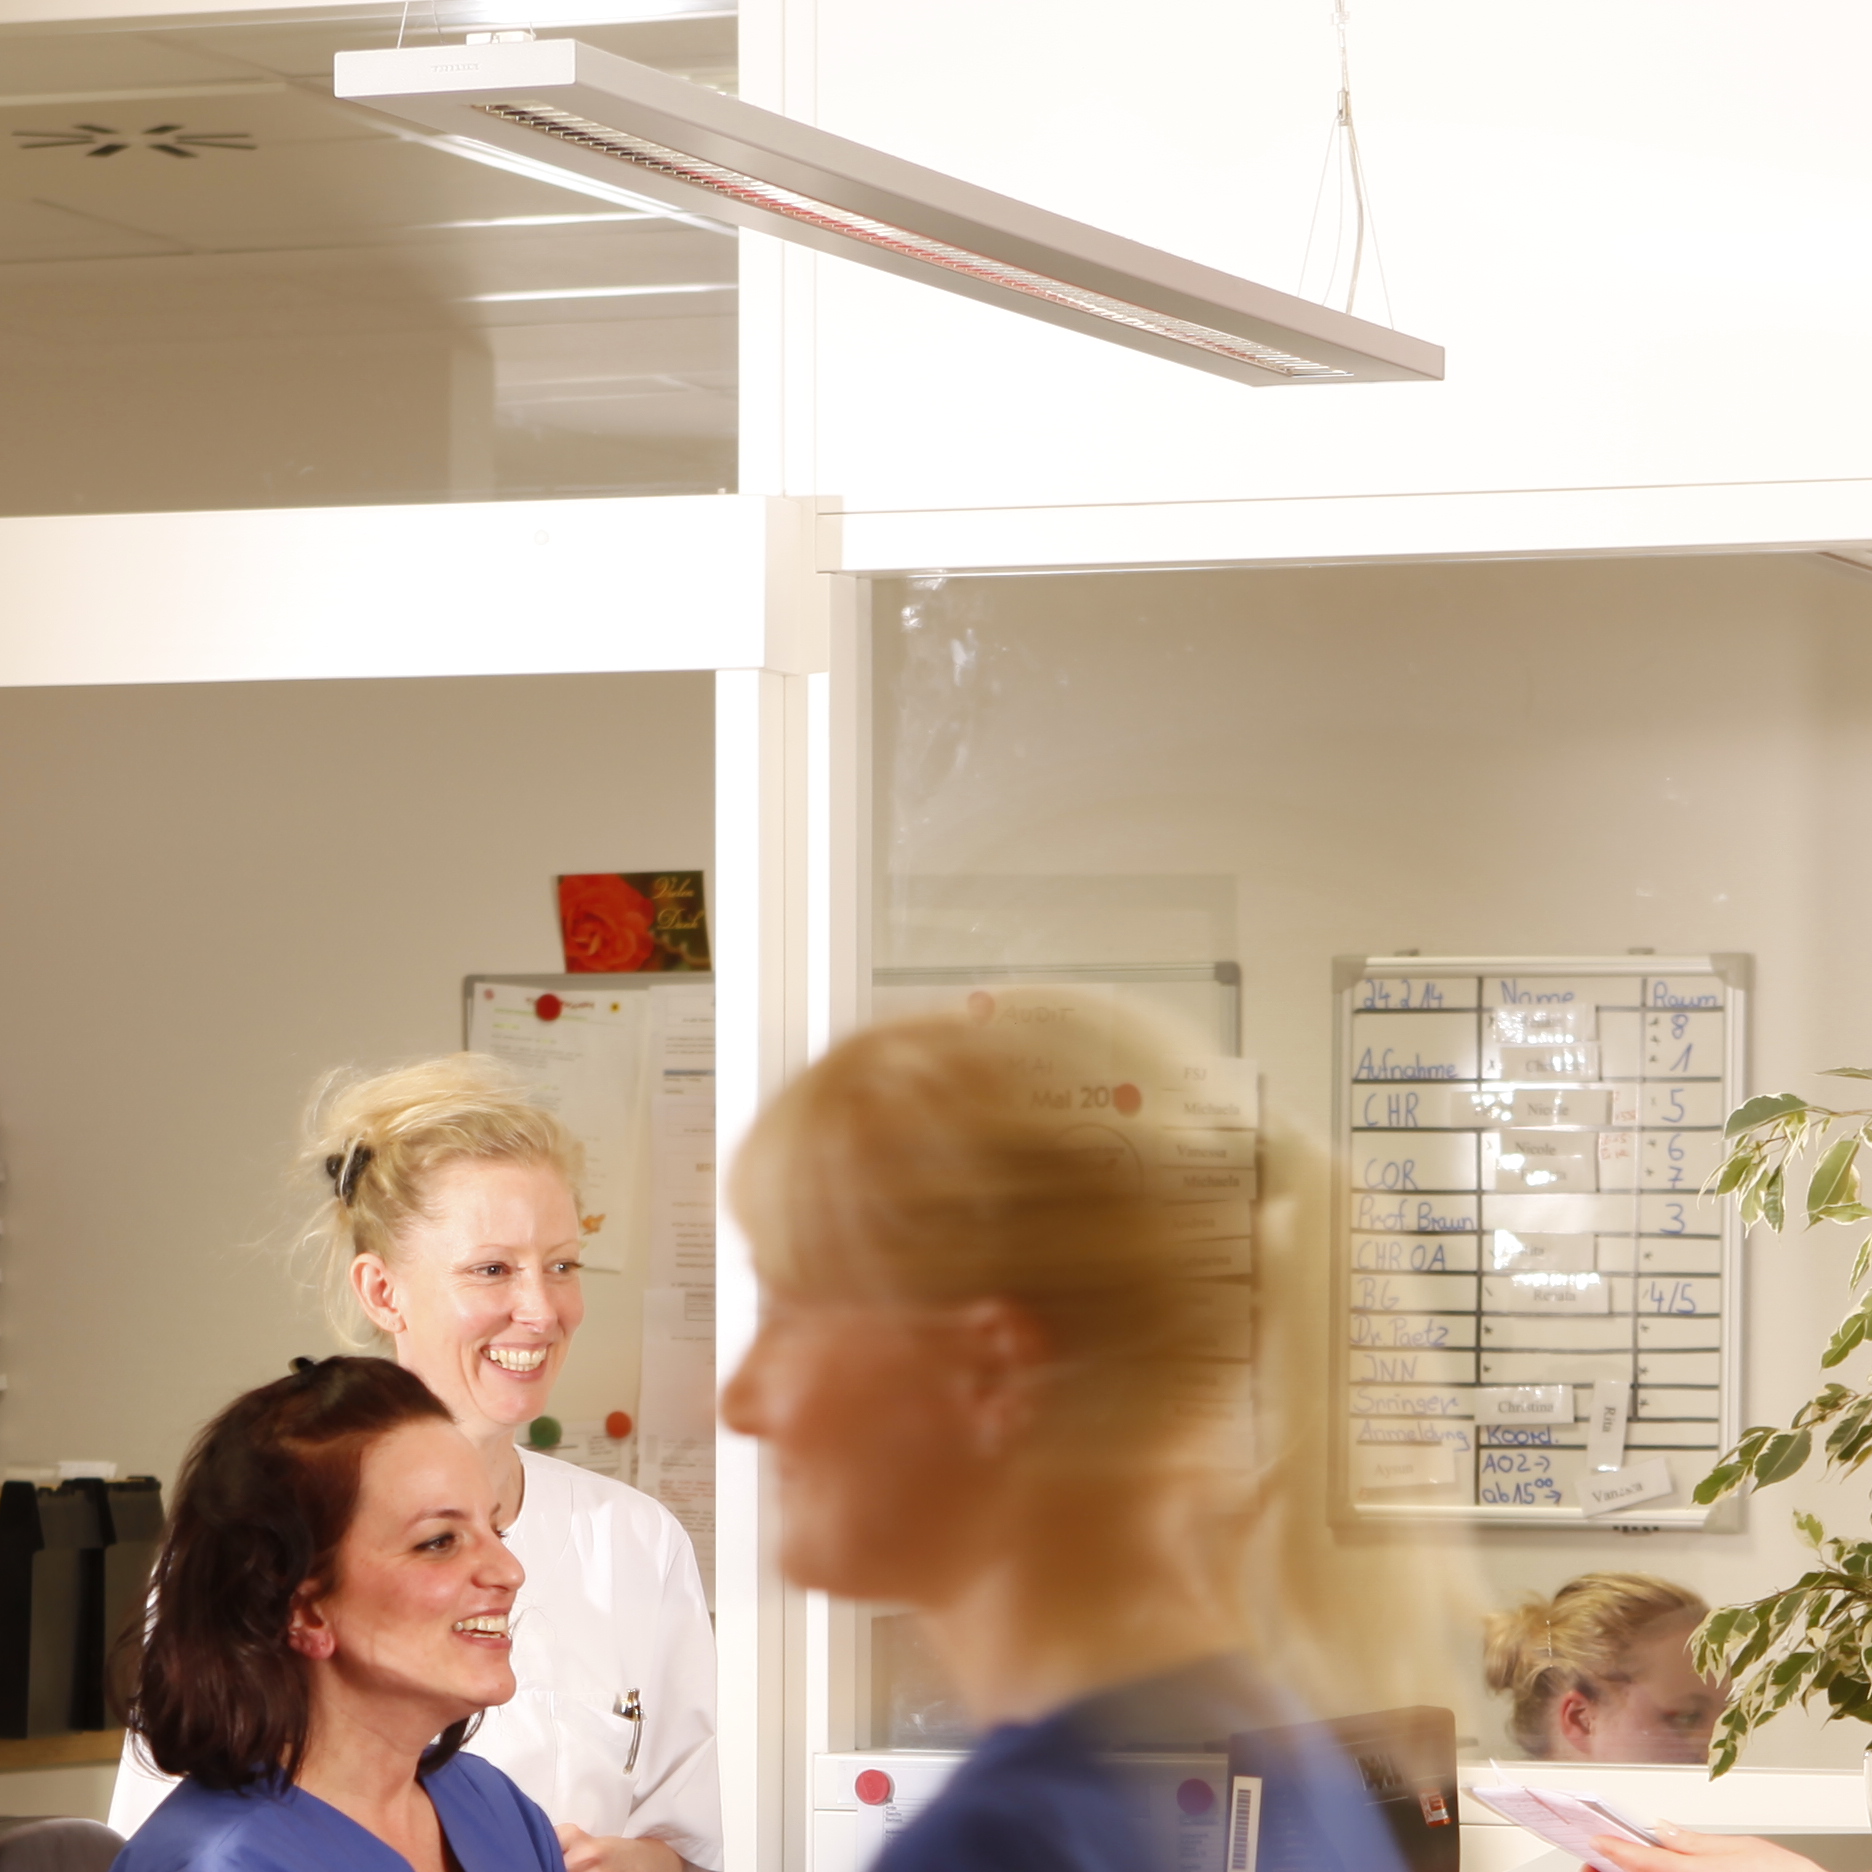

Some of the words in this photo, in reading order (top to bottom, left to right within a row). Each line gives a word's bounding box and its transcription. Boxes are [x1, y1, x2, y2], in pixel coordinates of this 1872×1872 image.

[1500, 980, 1575, 1005] Name
[1652, 981, 1719, 1007] Raum
[1669, 1013, 1690, 1040] 8
[1354, 1047, 1459, 1080] Aufnahme
[1669, 1042, 1695, 1073] 1
[1363, 1092, 1420, 1128] CHR
[1527, 1102, 1570, 1117] Nicoe
[1661, 1087, 1686, 1124] 5
[1514, 1141, 1558, 1157] Nicole
[1668, 1133, 1686, 1161] 6
[1364, 1158, 1417, 1190] COR
[1666, 1164, 1686, 1188] 7
[1416, 1201, 1476, 1231] Braun
[1659, 1203, 1686, 1235] 3
[1357, 1240, 1403, 1271] CHR
[1389, 1317, 1450, 1347] Paetz
[1601, 1405, 1617, 1434] Rita
[1359, 1418, 1472, 1452] Anmeldung
